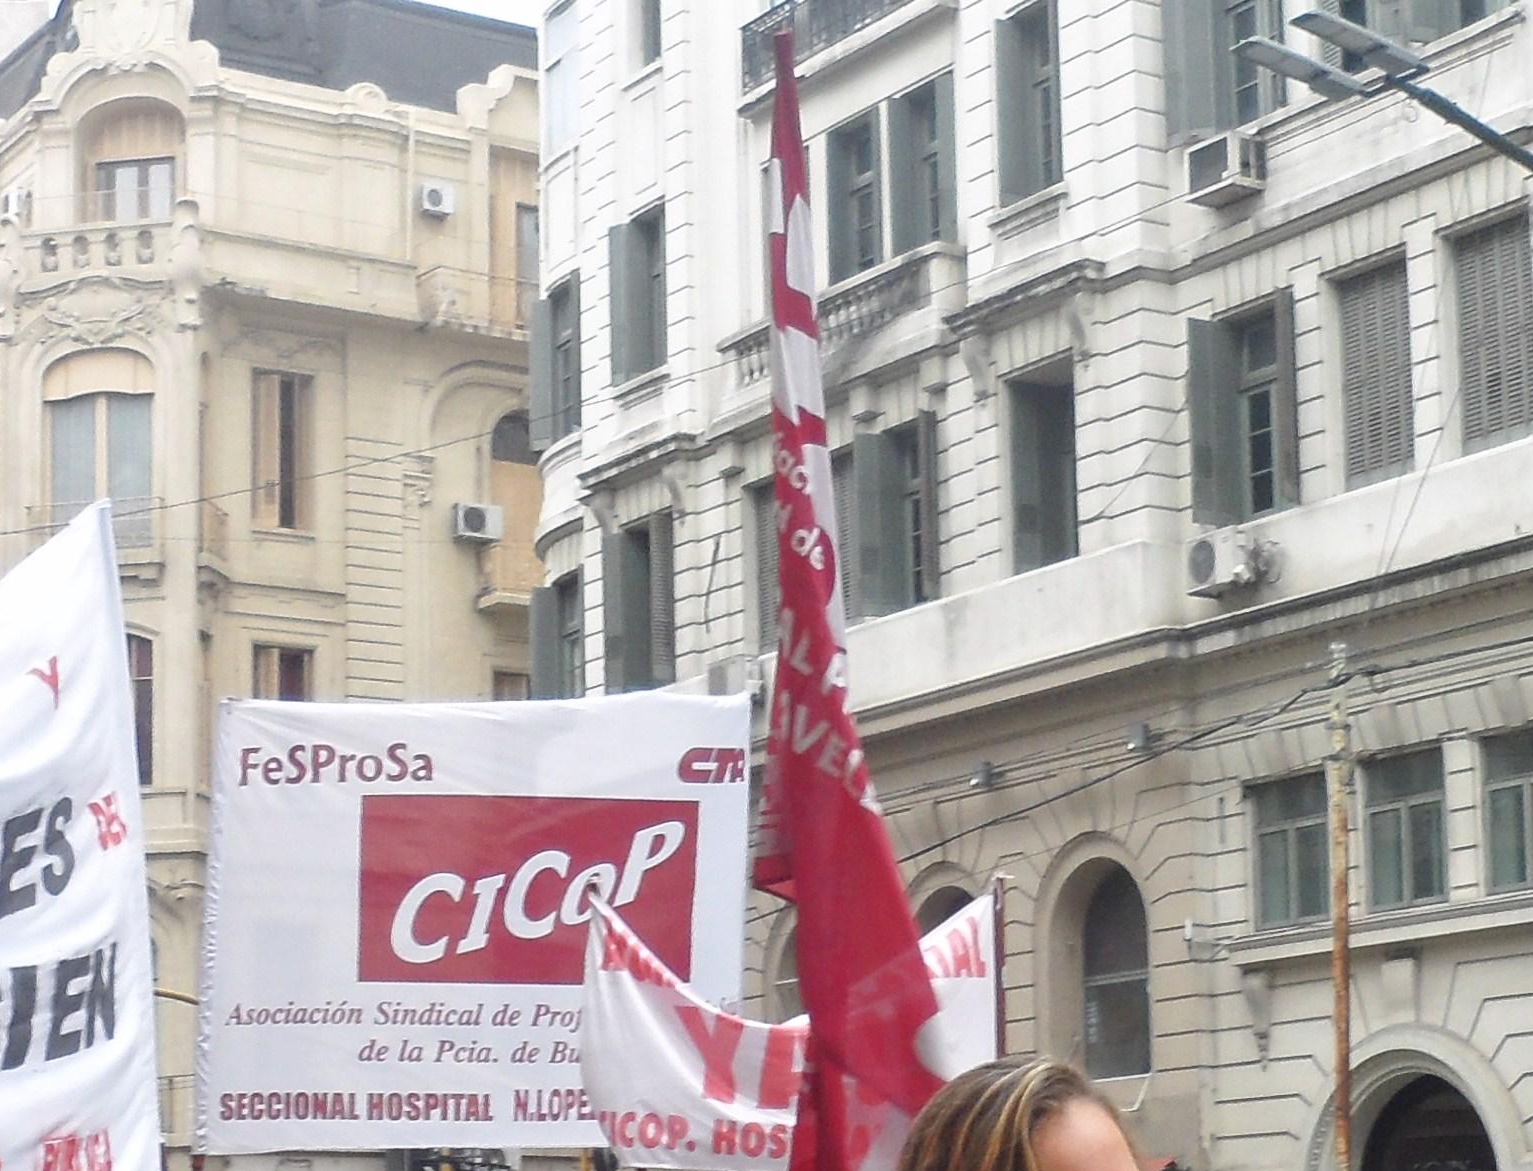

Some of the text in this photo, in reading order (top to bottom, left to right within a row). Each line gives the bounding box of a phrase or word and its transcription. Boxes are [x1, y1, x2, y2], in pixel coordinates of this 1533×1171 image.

[27, 655, 62, 711] Y
[238, 742, 434, 787] FeSProSa
[225, 1001, 364, 1028] Asociación
[374, 1001, 484, 1028] Sindical
[491, 1003, 522, 1027] de
[357, 1040, 390, 1063] de
[398, 1040, 423, 1063] la
[433, 1040, 499, 1064] Pcia.
[510, 1040, 540, 1063] de
[220, 1092, 359, 1122] SECCIONAL
[367, 1092, 493, 1123] HOSPITAL
